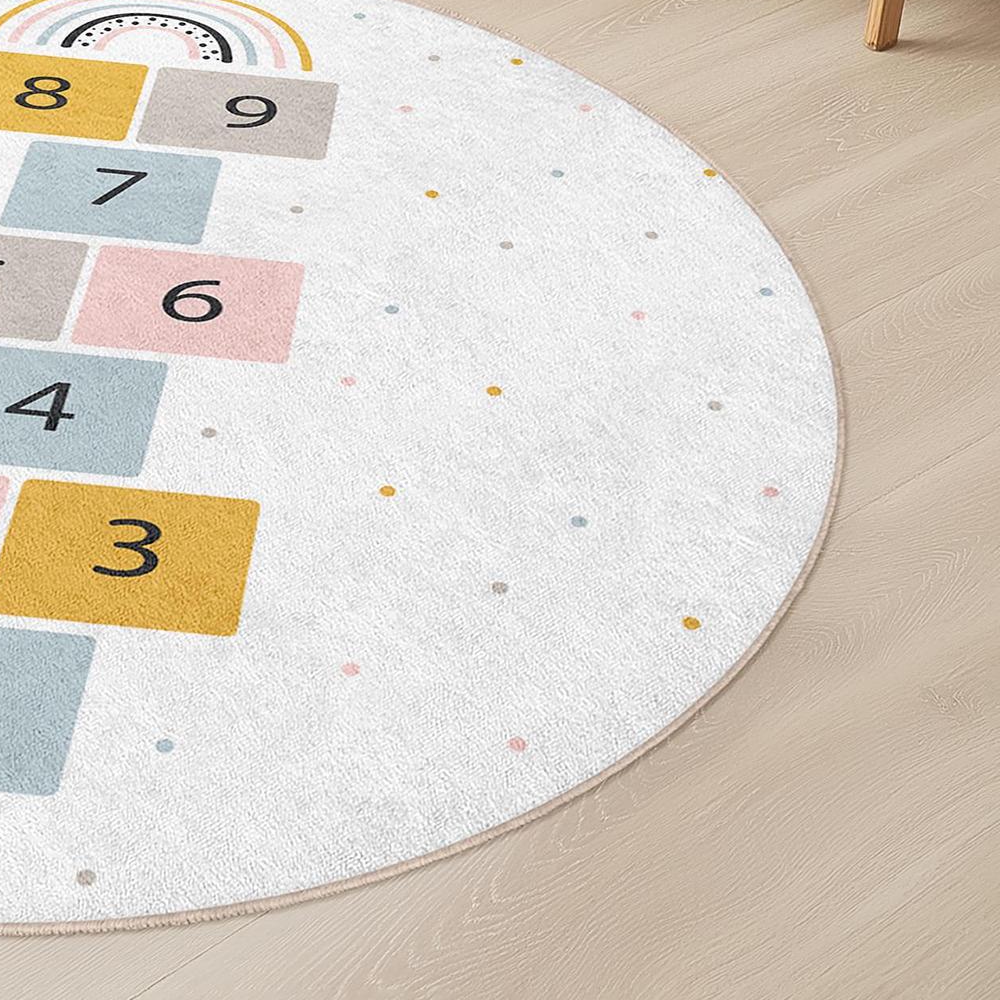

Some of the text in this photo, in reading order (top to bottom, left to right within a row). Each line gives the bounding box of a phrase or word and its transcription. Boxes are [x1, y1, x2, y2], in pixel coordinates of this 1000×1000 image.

[14, 76, 71, 110] 8
[225, 95, 278, 129] 9
[91, 167, 148, 206] 7
[161, 279, 223, 323] 6
[4, 381, 75, 432] 4
[92, 518, 162, 578] 3
